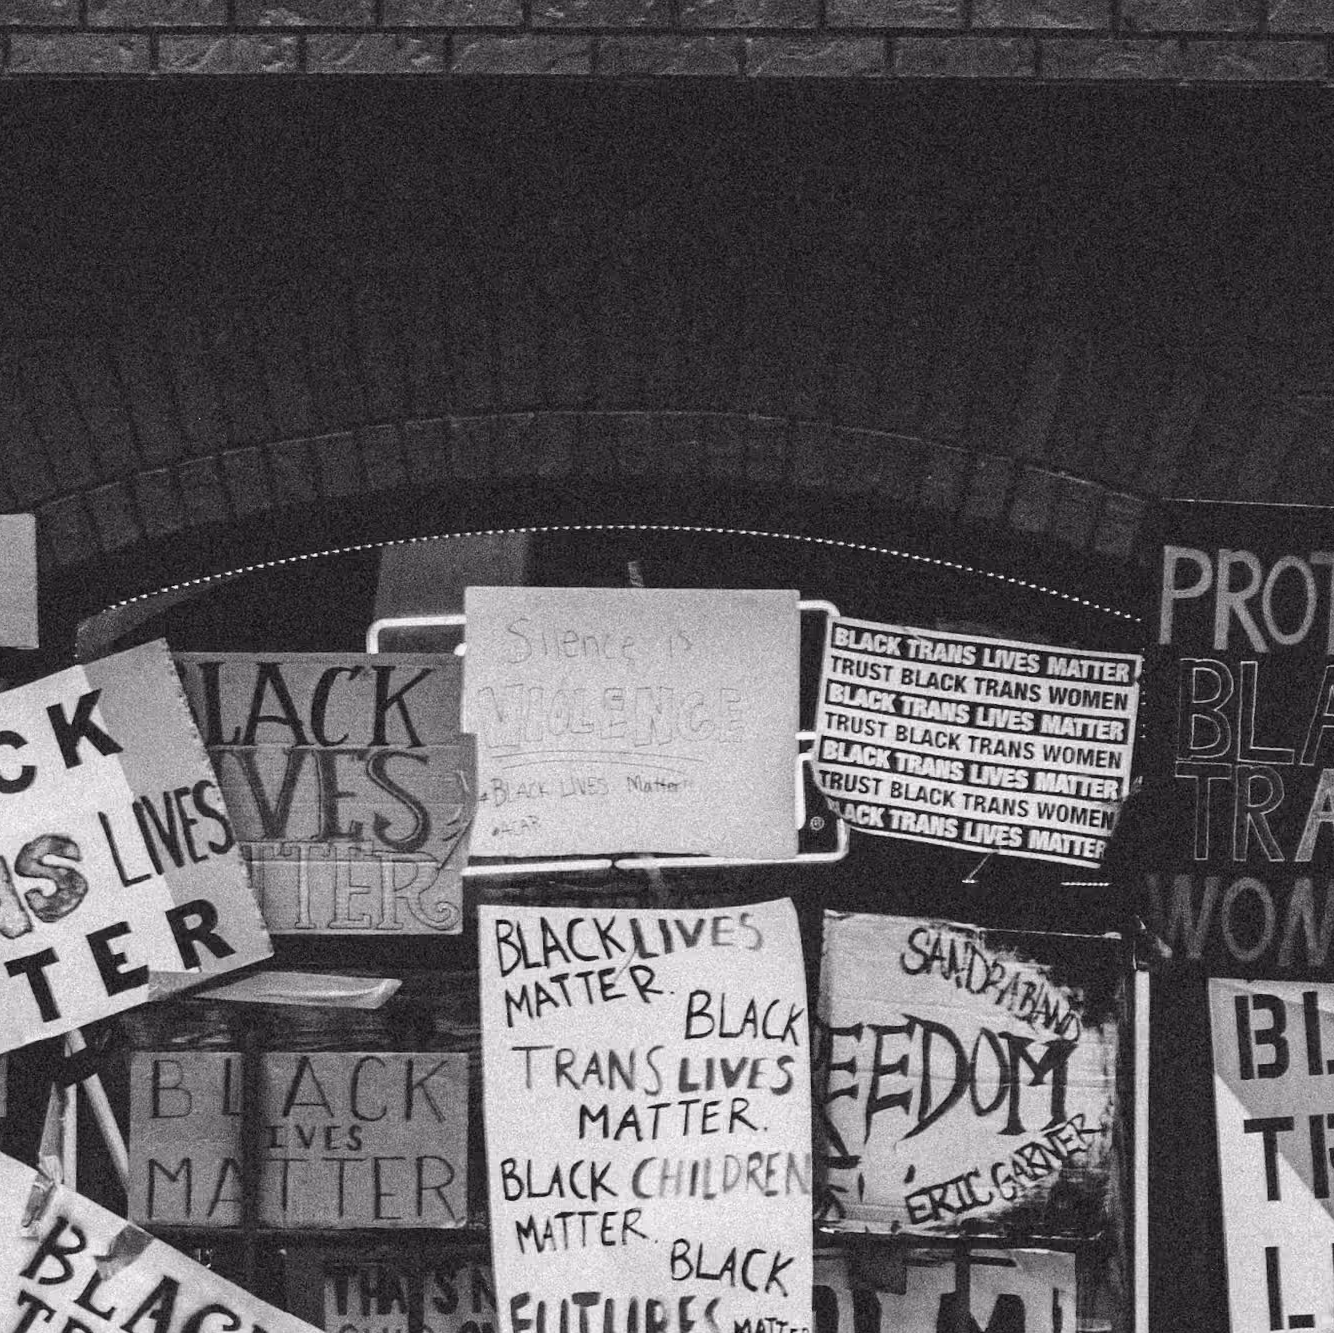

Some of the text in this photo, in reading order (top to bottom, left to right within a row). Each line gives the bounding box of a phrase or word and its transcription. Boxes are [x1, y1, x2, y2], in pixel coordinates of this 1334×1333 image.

[834, 623, 1130, 683] BLACK TRANS LIVES MATTER
[831, 656, 1128, 711] TRUST BLACK TRANS WOMEN
[98, 779, 235, 887] LIVES
[496, 913, 763, 977] BLACK LIVES
[505, 965, 677, 1028] MATTER.
[685, 990, 805, 1047] BLACK
[150, 1056, 449, 1122] BLACK
[512, 1044, 795, 1096] TRANS LIVES
[579, 1097, 769, 1142] MATTER.
[148, 1154, 463, 1222] MATTER
[501, 1158, 619, 1200] BLACK
[632, 1151, 811, 1199] CHILDREN
[905, 1168, 993, 1224] ERIC
[516, 1208, 659, 1254] MATTER.
[670, 1238, 794, 1298] BLACK
